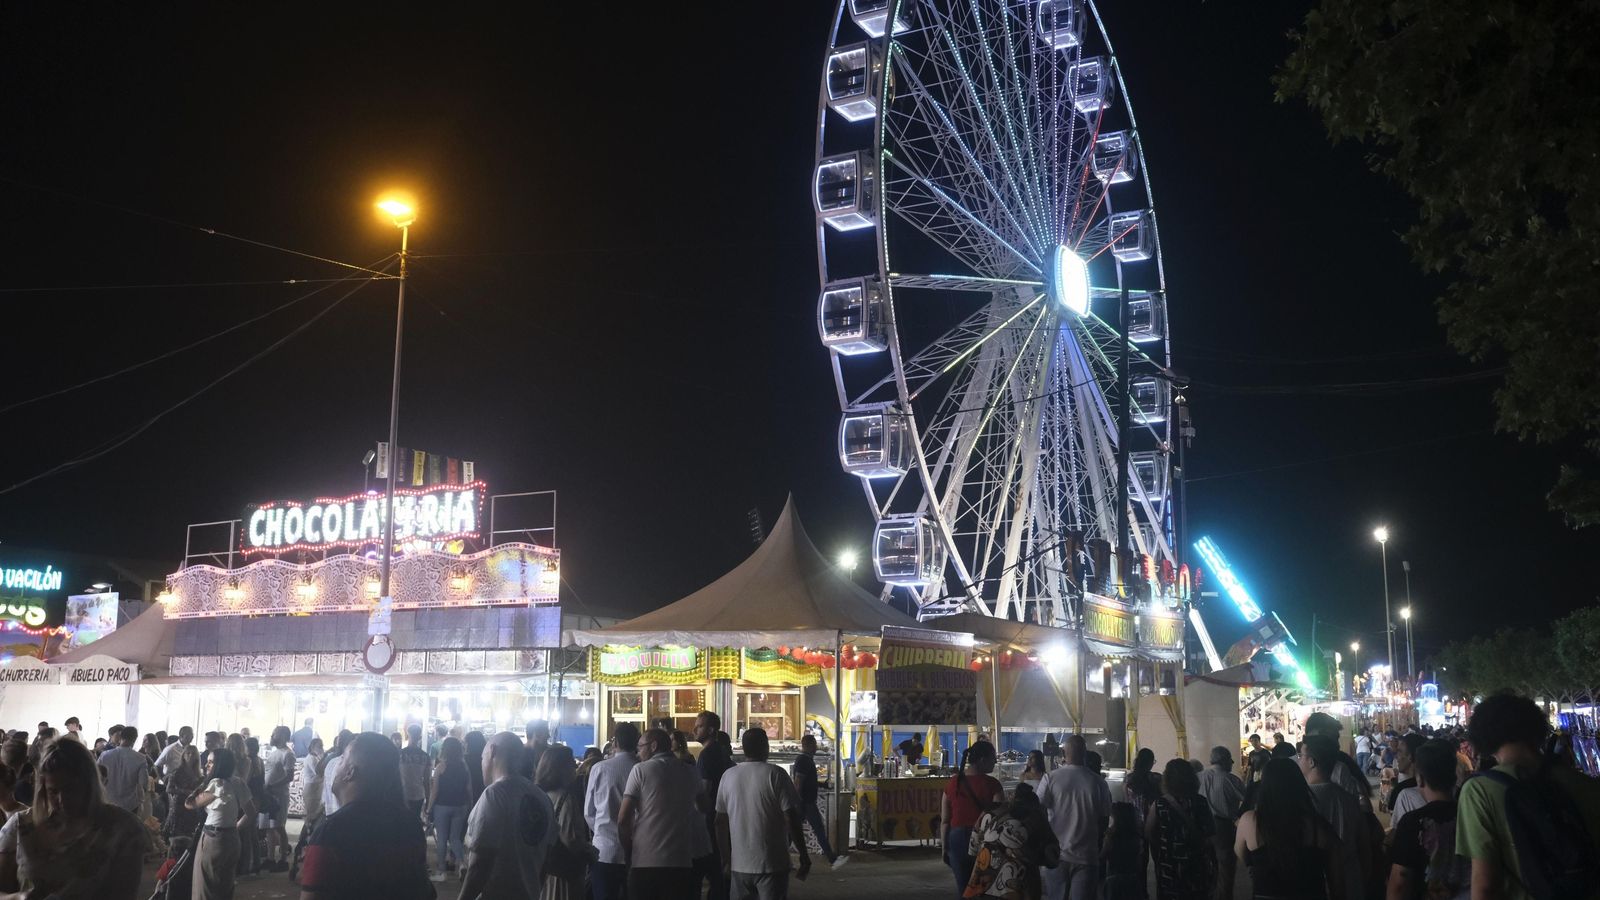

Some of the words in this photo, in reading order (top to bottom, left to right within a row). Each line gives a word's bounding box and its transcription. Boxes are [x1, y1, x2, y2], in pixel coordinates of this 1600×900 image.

[5, 565, 62, 591] VACILÓN
[608, 651, 690, 672] TAQUILLA
[0, 668, 50, 682] CHURRERIA
[70, 668, 105, 682] ABUELO
[106, 667, 130, 682] PACO
